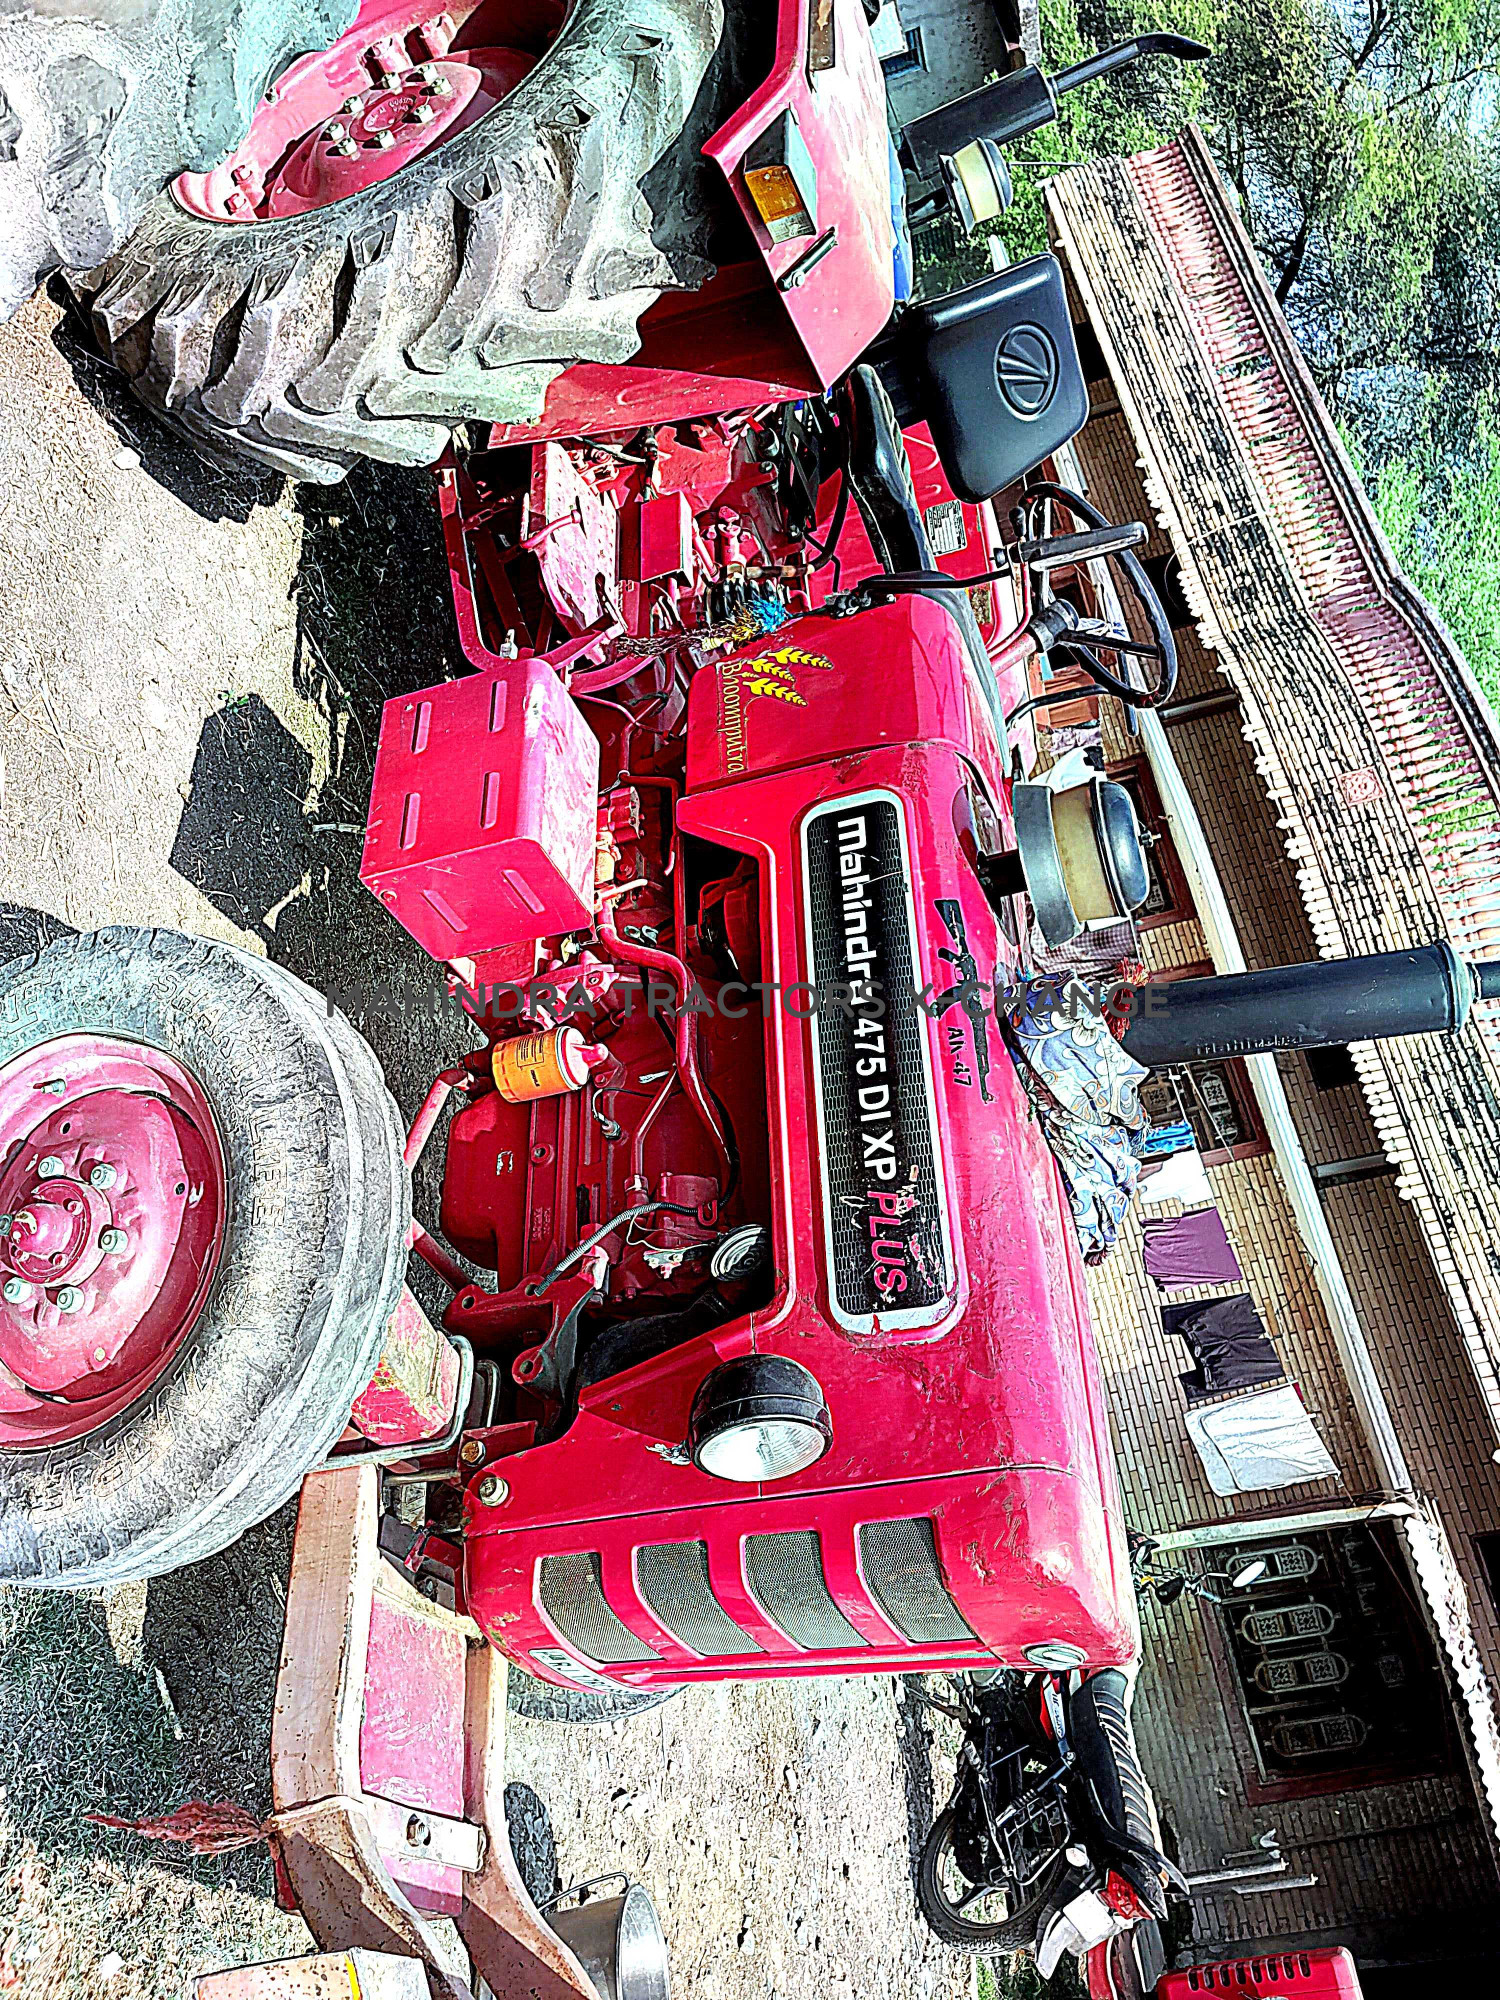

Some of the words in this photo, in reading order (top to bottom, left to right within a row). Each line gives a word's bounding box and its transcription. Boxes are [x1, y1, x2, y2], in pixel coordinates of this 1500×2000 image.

[717, 662, 746, 774] Bhoomiputra
[853, 1018, 887, 1077] 475
[947, 1027, 972, 1086] AK-47
[150, 969, 273, 1098] SHAKTI
[248, 1106, 288, 1228] LIFE
[858, 1084, 890, 1122] DI
[862, 1132, 897, 1180] XP
[866, 1190, 907, 1293] PLUS
